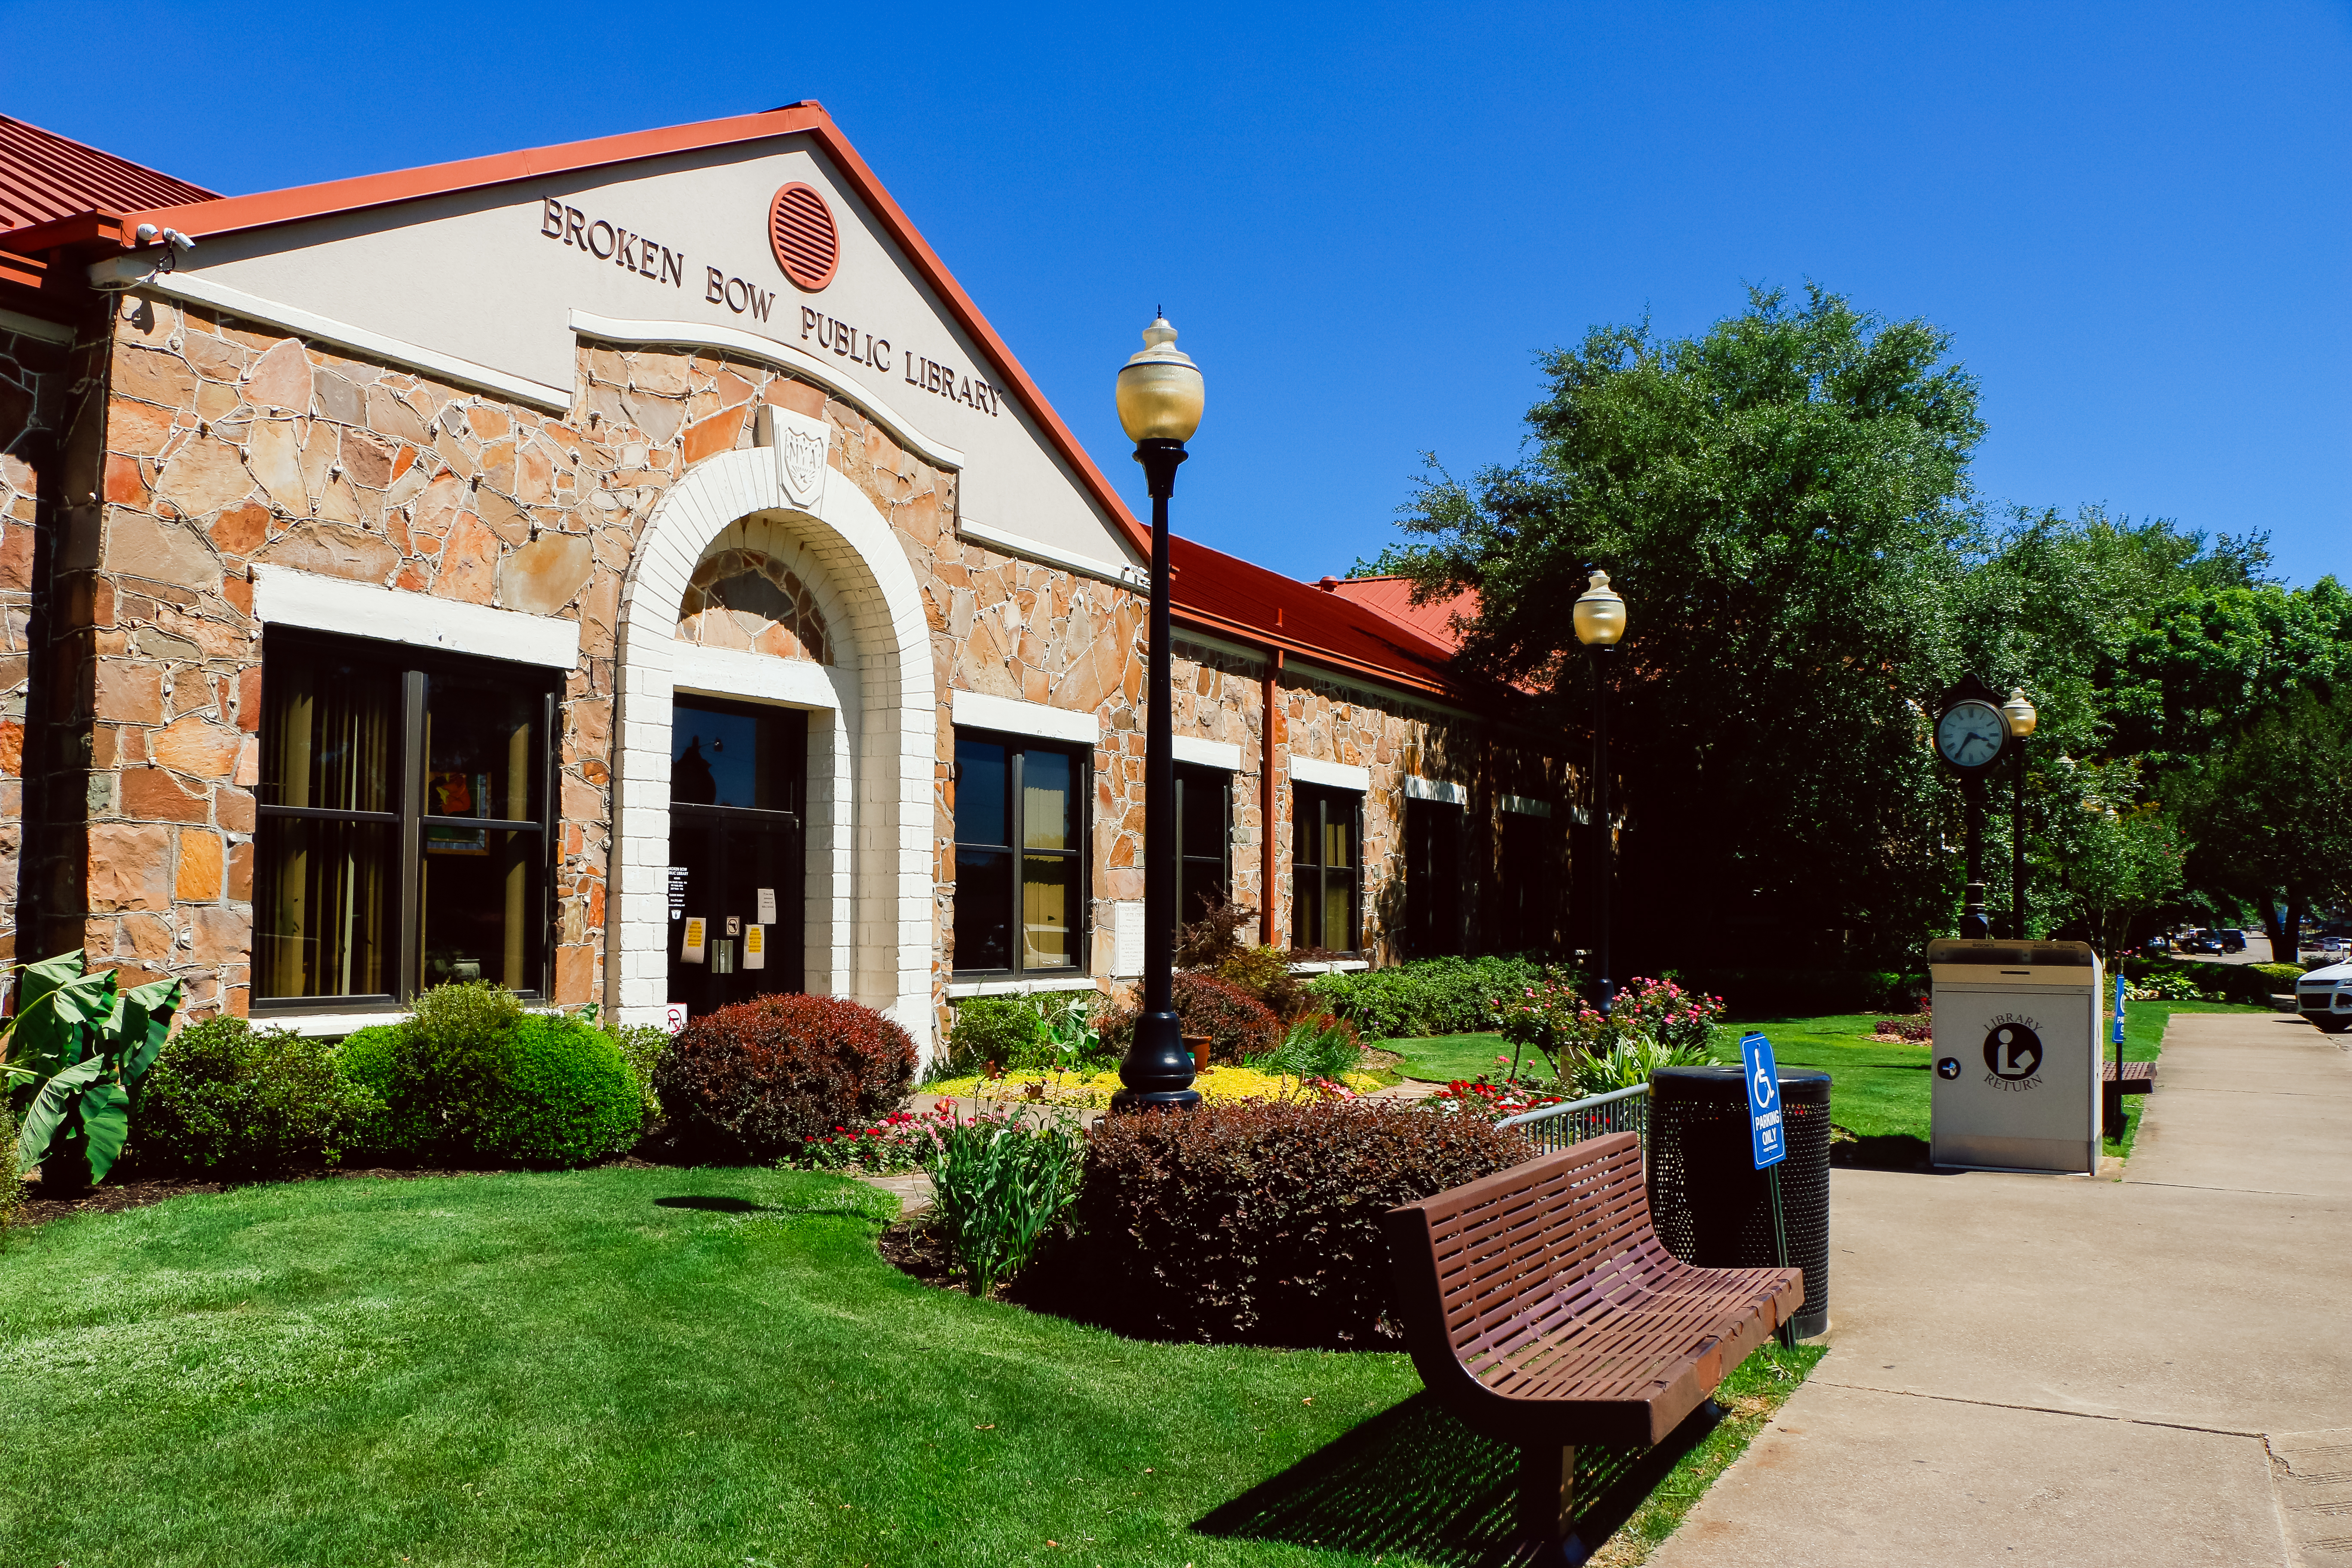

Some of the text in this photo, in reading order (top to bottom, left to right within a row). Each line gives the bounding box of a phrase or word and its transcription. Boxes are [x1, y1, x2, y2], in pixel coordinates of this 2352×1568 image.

[541, 196, 1004, 417] BROKEN BOW PUBLIC LIBRARY
[1983, 1013, 2043, 1032] LIBRARY
[1984, 1072, 2043, 1092] RETURN
[1755, 1109, 1780, 1131] PARKING
[1762, 1127, 1777, 1145] ONLY
